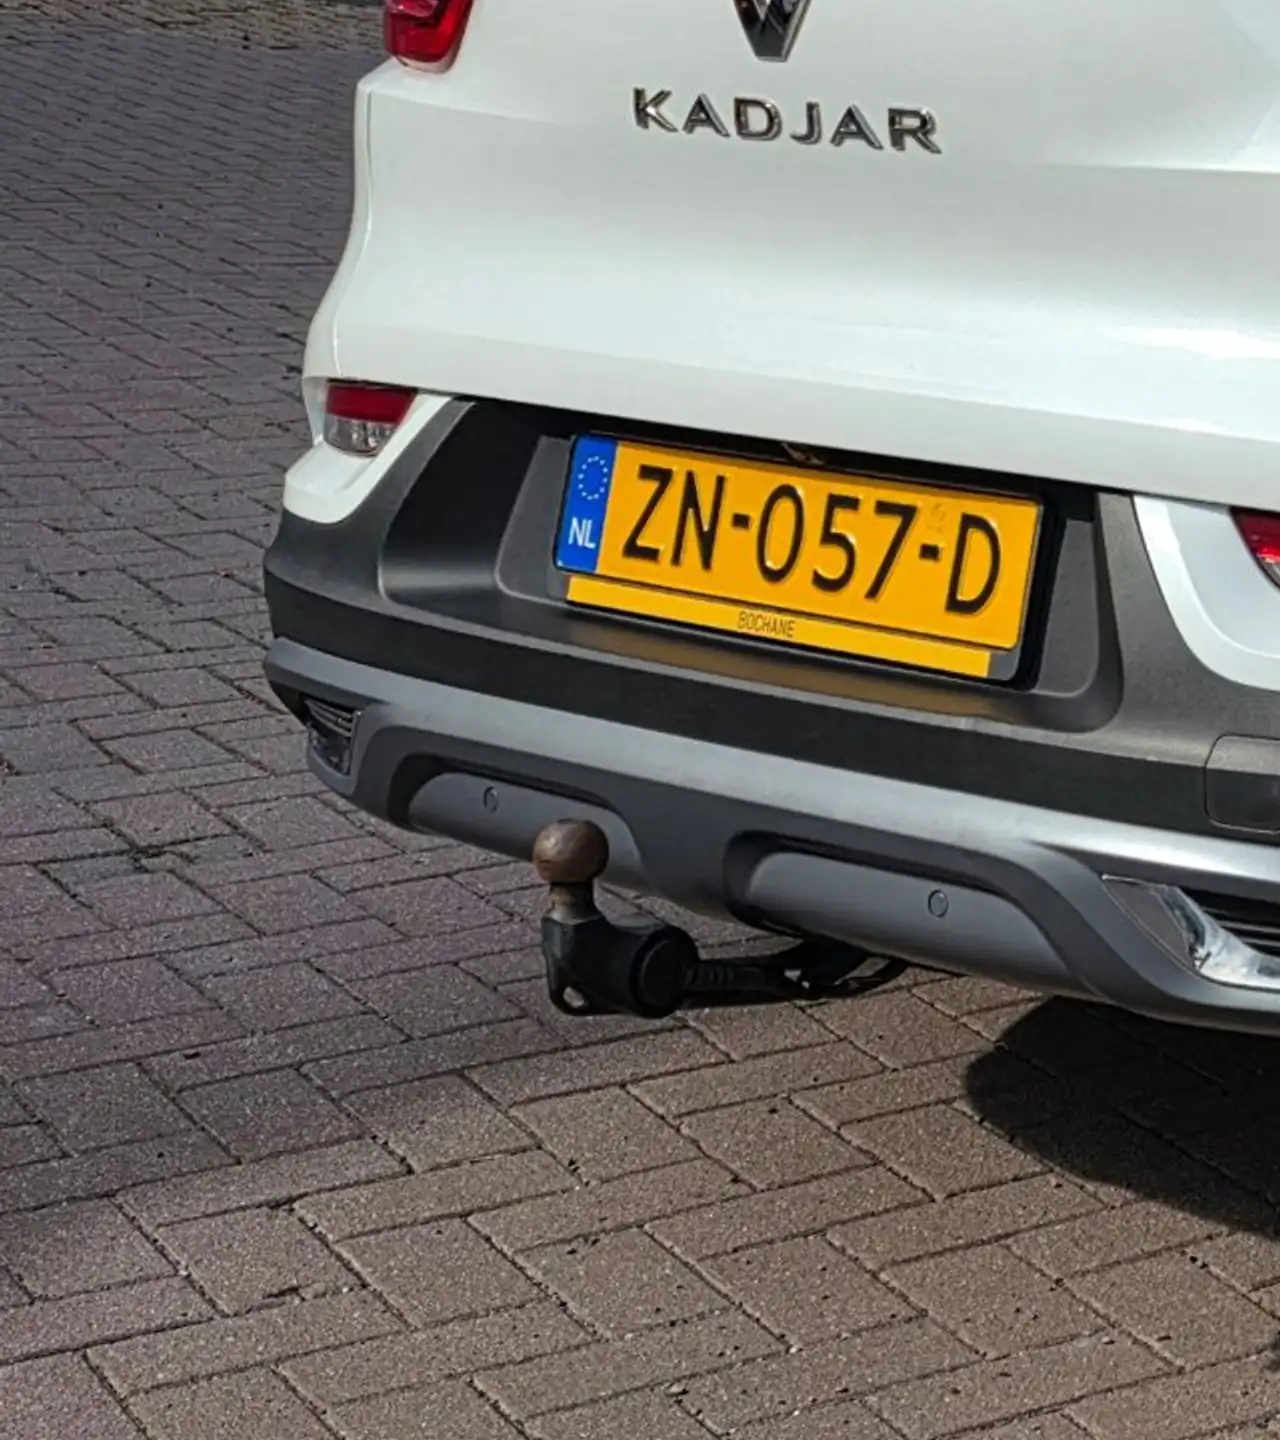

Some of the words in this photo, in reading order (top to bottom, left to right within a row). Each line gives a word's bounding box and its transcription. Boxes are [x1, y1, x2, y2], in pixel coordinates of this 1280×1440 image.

[633, 87, 942, 154] KADJAR
[568, 516, 597, 550] NL
[622, 464, 1002, 616] ZN-057-D
[738, 610, 796, 638] BOCHANE
